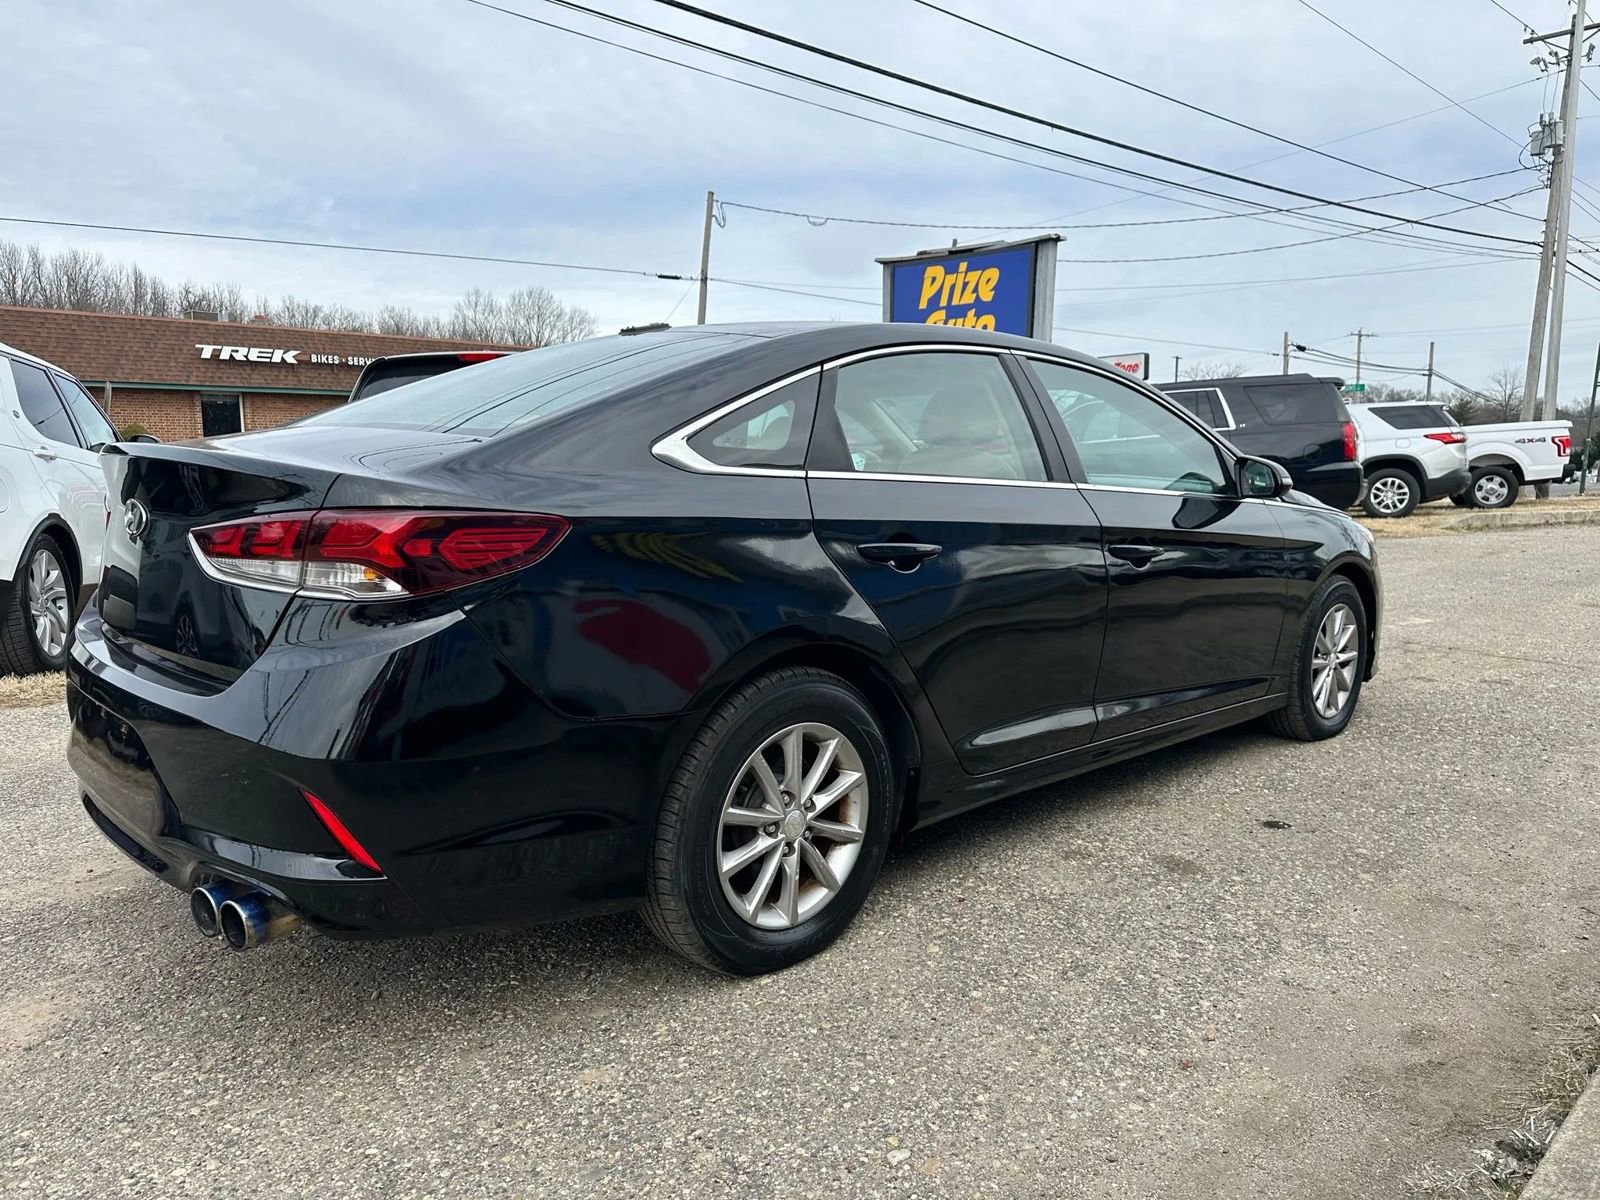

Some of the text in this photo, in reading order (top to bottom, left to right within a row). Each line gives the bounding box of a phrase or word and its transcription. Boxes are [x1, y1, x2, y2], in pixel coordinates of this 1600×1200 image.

[919, 261, 999, 309] Prize
[925, 308, 996, 331] to
[195, 344, 376, 366] TREK BIKES SERV
